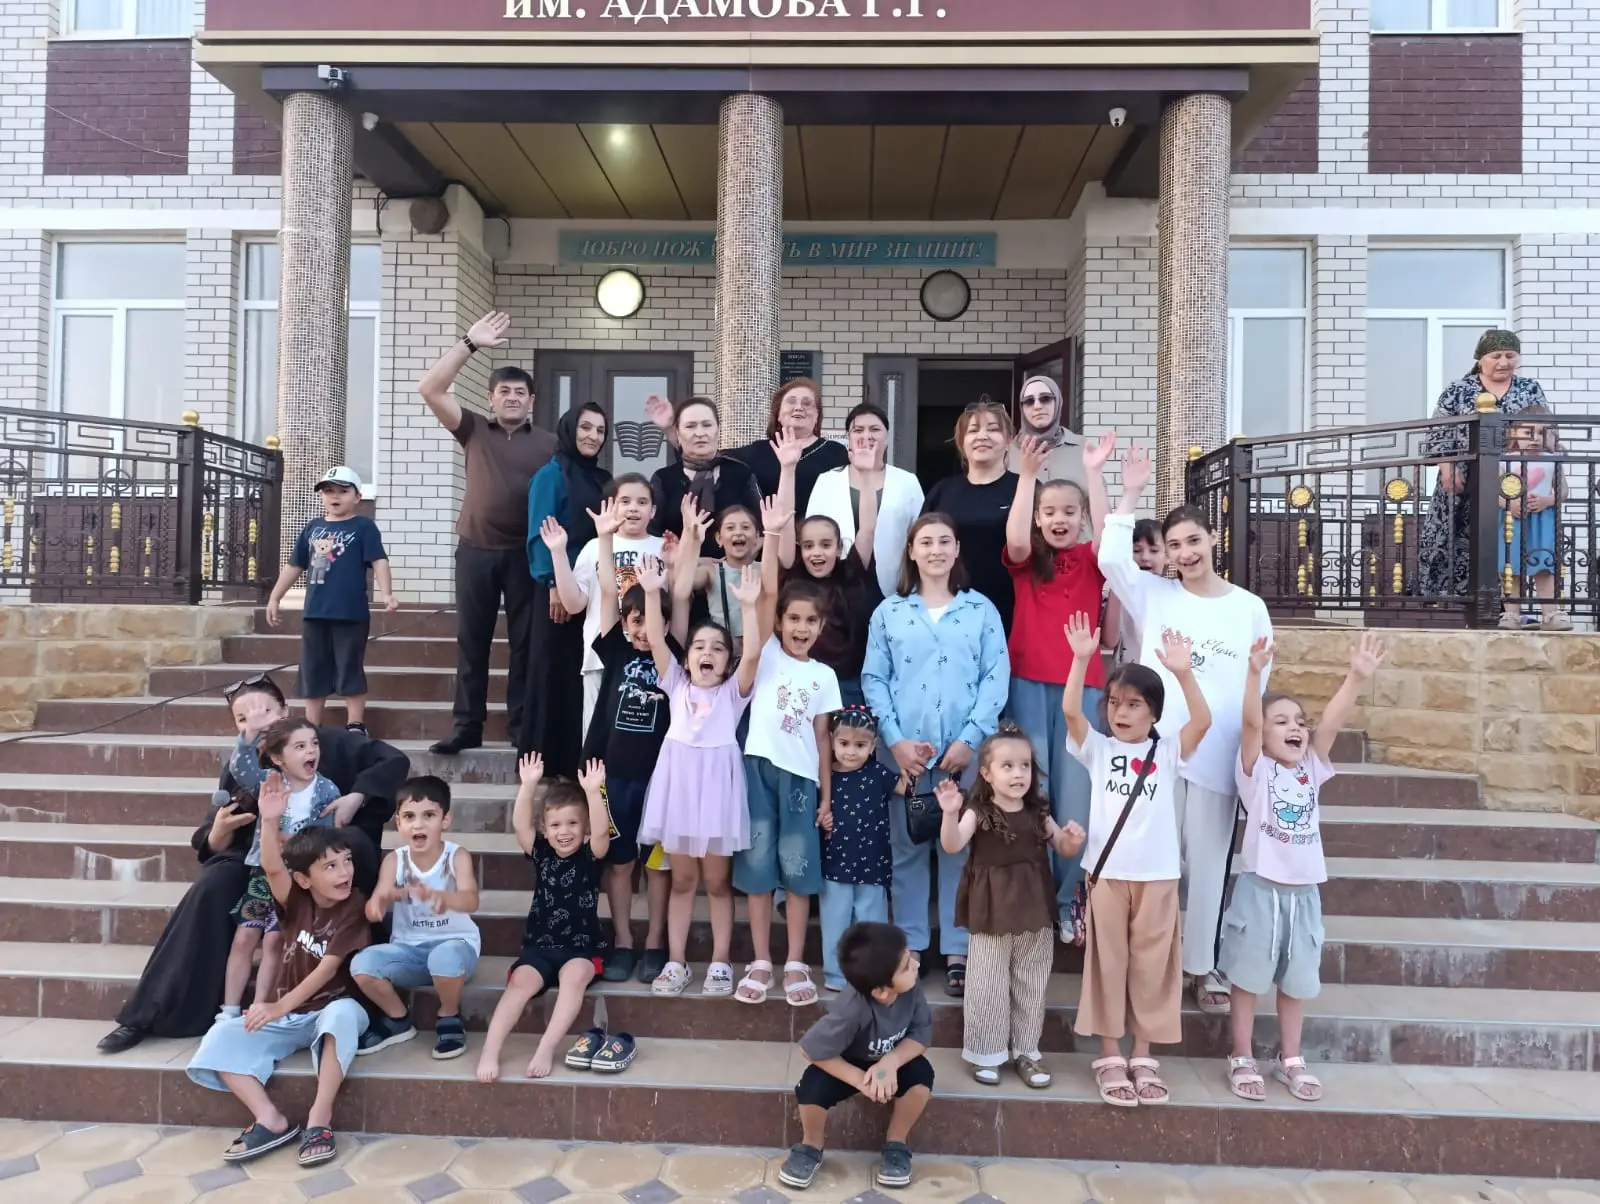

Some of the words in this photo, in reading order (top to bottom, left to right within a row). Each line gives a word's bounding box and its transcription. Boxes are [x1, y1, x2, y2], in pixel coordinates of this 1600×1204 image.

[807, 241, 821, 258] В
[829, 241, 878, 258] МИР
[1111, 755, 1127, 777] Я
